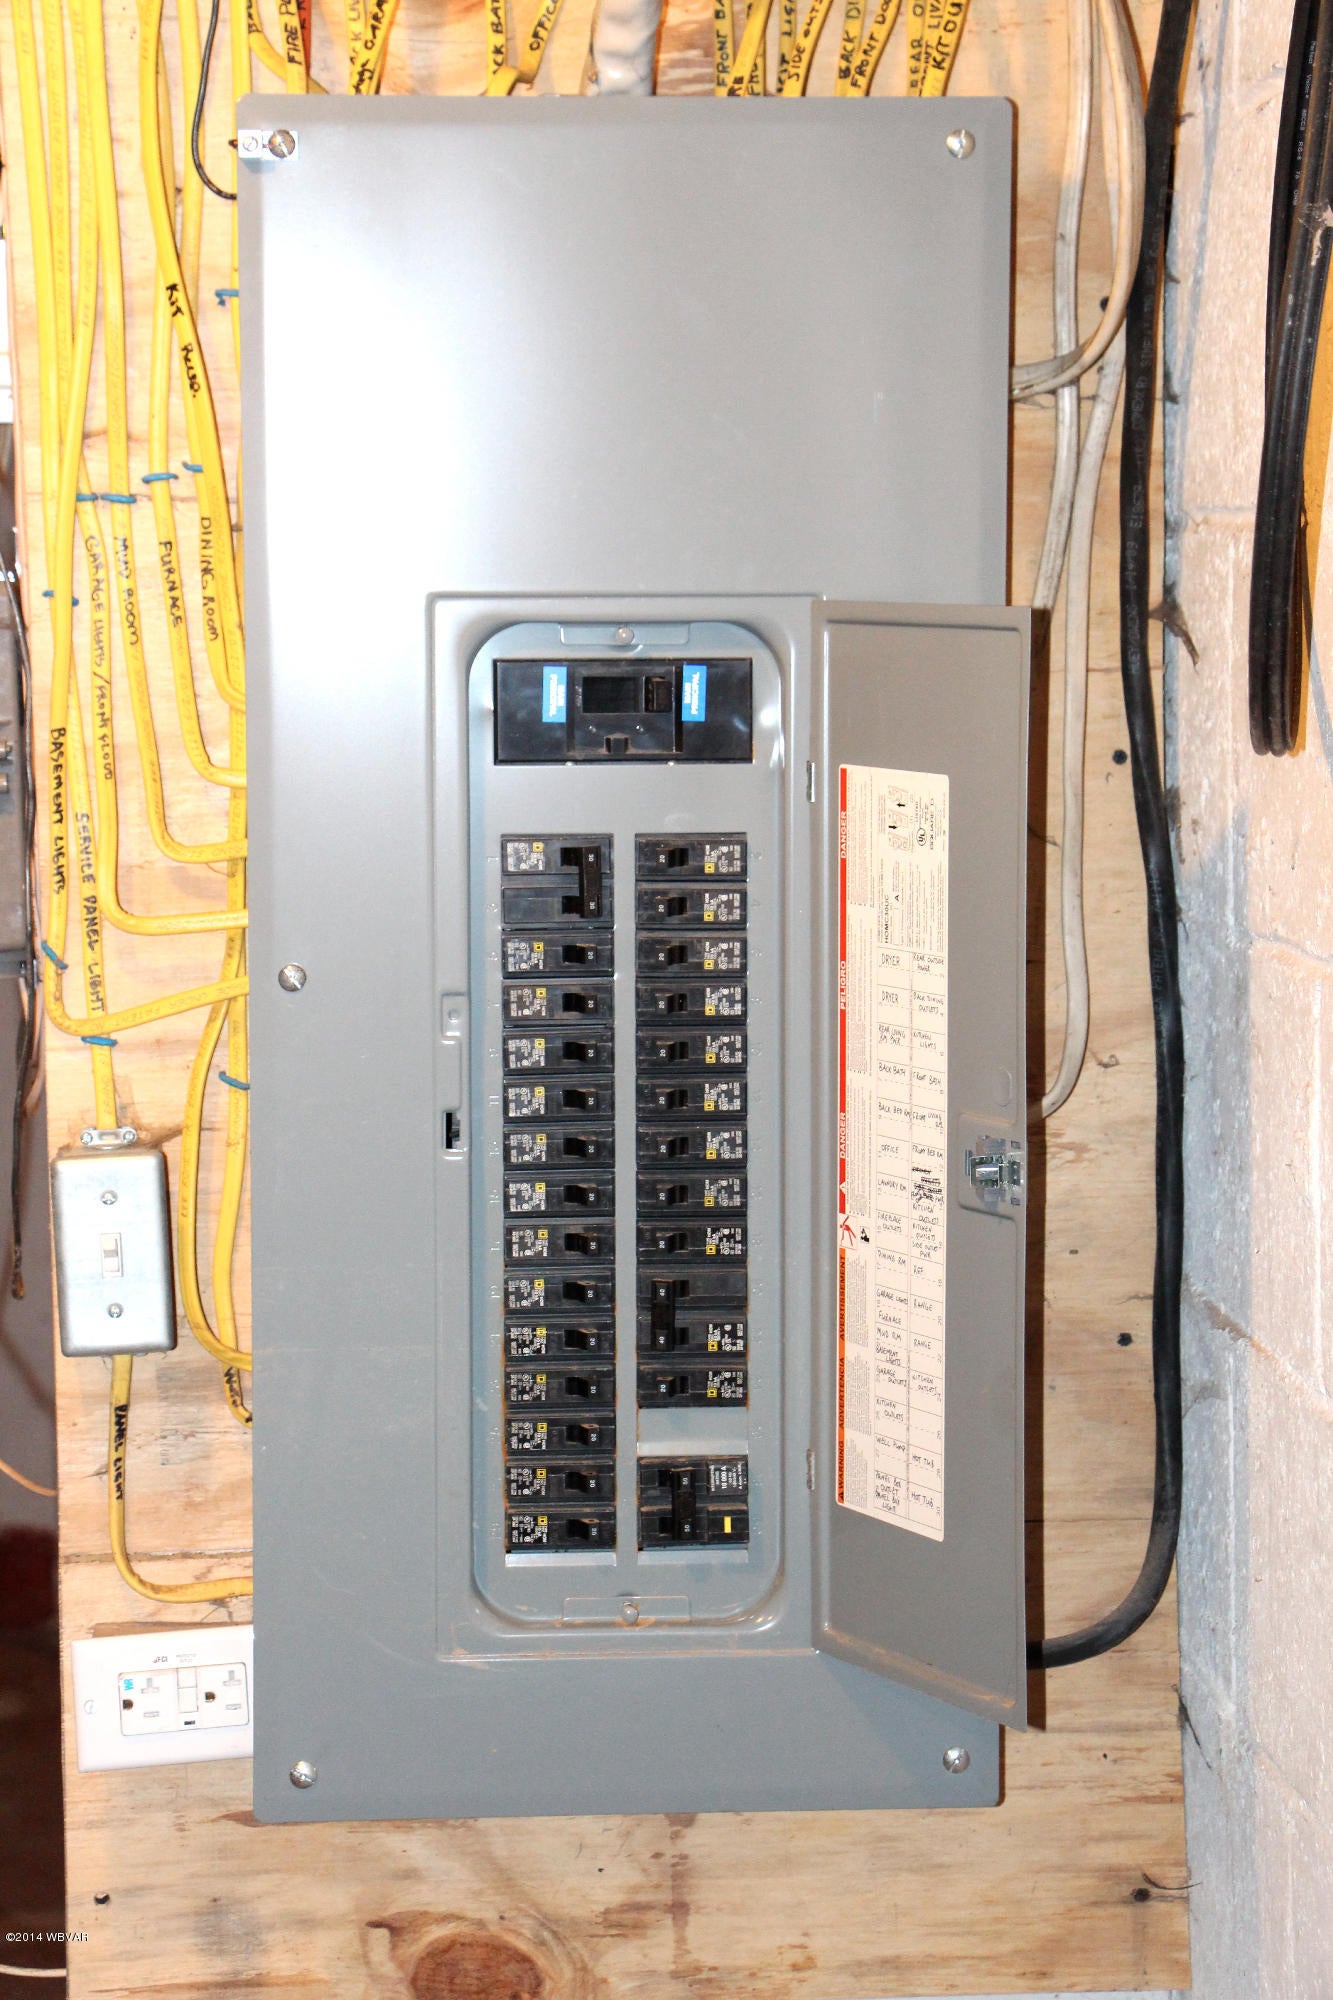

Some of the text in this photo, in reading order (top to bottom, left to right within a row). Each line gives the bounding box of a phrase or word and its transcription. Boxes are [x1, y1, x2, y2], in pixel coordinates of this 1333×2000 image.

[284, 22, 302, 65] FIRE
[716, 33, 728, 87] FRONT
[788, 46, 804, 82] SIDE
[852, 33, 880, 88] FRONT
[932, 39, 947, 72] KIT
[159, 540, 182, 628] FURNACE
[200, 516, 219, 642] DINING ROOM
[123, 588, 138, 646] ROOM
[50, 727, 67, 894] BASEMENT LIGHTS
[75, 812, 105, 1013] SERVICE PANEL LIGHT
